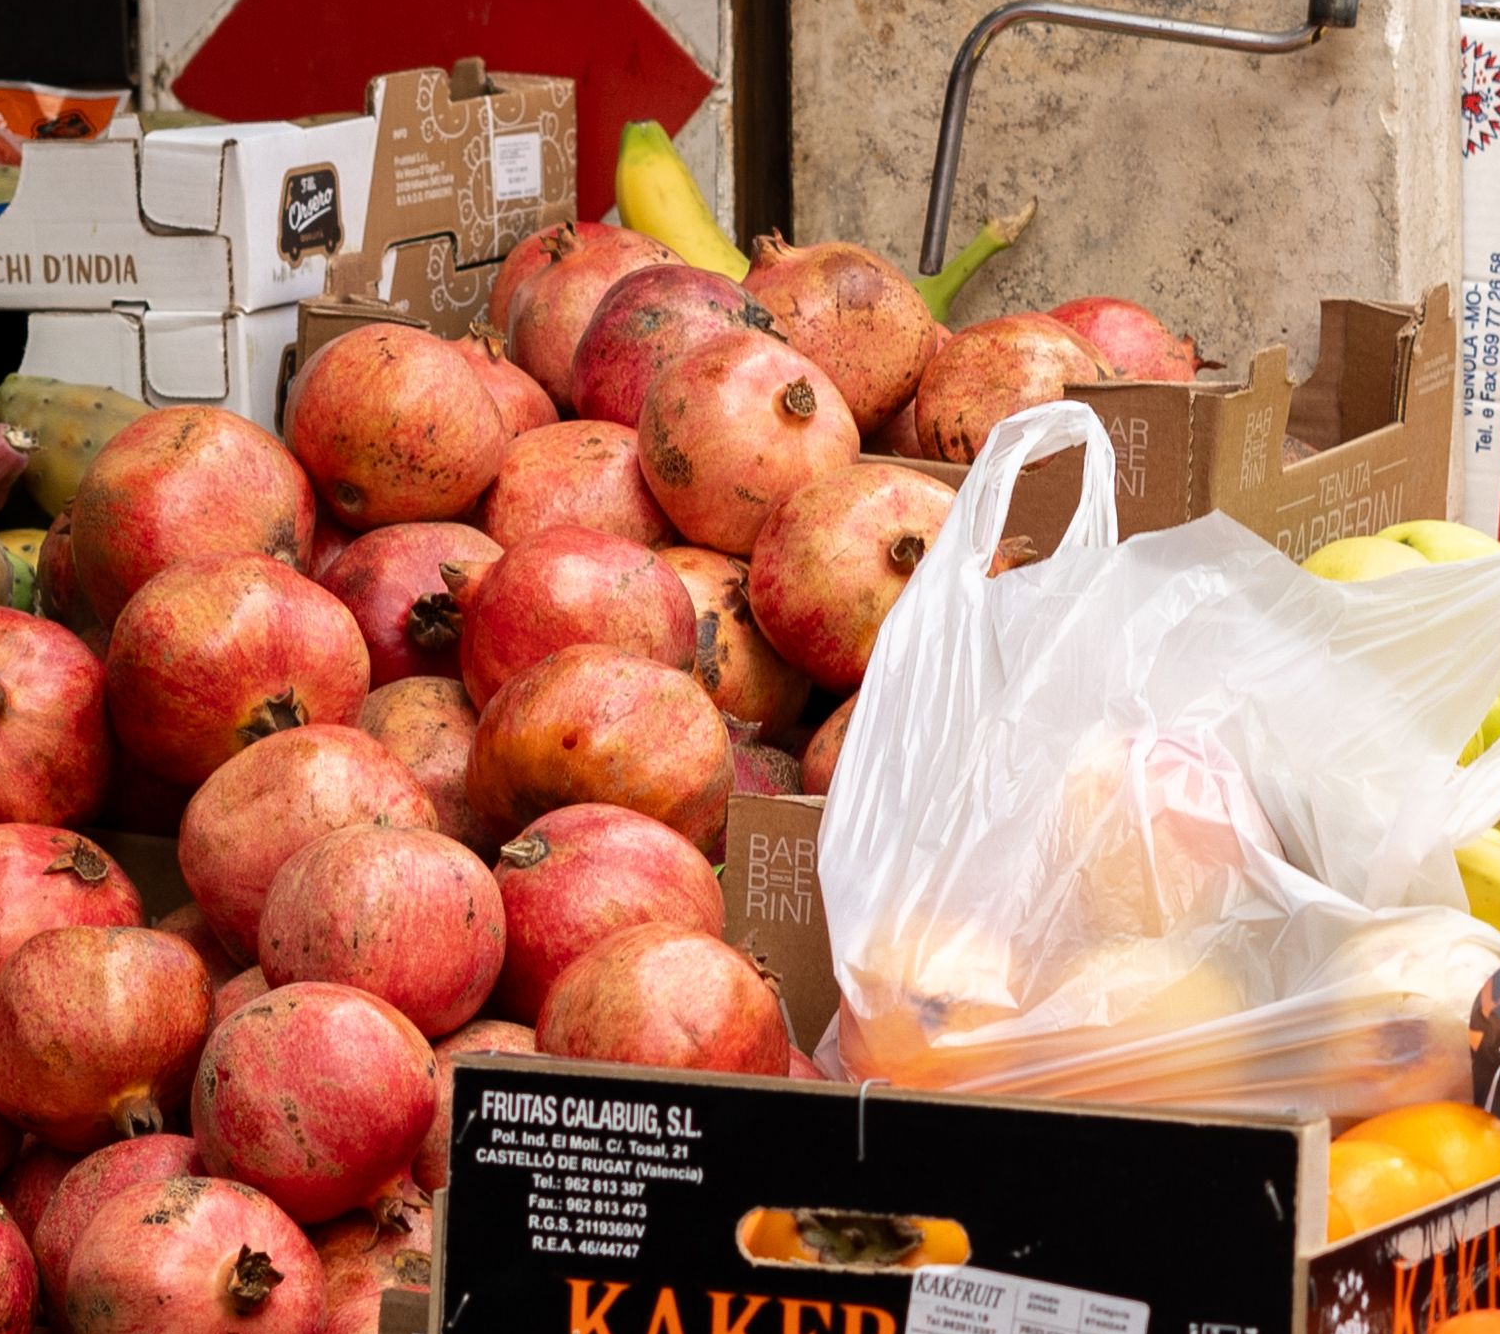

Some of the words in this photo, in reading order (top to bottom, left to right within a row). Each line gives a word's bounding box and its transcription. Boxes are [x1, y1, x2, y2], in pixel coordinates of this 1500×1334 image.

[288, 188, 334, 230] Orsero
[43, 254, 138, 285] D'INDIA
[1482, 334, 1500, 368] 059
[1480, 371, 1498, 403] Fax
[1246, 406, 1273, 434] BAR
[1481, 408, 1495, 419] e
[1475, 419, 1494, 453] Tel.
[1239, 457, 1267, 492] RINI
[1318, 460, 1371, 508] TENUTA
[750, 833, 816, 868] BAR
[747, 890, 813, 926] RINI
[482, 1090, 557, 1126] FRUTAS
[562, 1097, 662, 1139] CALABUIG,
[667, 1106, 702, 1138] S.L.
[492, 1128, 518, 1145] Pol.
[522, 1131, 548, 1147] Ind.
[552, 1134, 566, 1149] El
[606, 1139, 625, 1154] C/.
[628, 1140, 668, 1159] Tosal,
[672, 1145, 689, 1159] 21
[476, 1147, 554, 1168] CASTELLÓ
[558, 1155, 578, 1170] DE
[582, 1157, 632, 1175] RUGAT
[635, 1162, 703, 1184] (Valencia)
[532, 1173, 561, 1189] Tel.:
[565, 1176, 589, 1193] 962
[593, 1180, 618, 1195] 813
[621, 1181, 646, 1197] 387
[528, 1194, 562, 1210] Fax.:
[566, 1197, 590, 1213] 962
[594, 1200, 619, 1215] 813
[622, 1202, 647, 1218] 473
[528, 1214, 572, 1232] R.G.S.
[575, 1218, 646, 1239] 2119369/V
[532, 1235, 575, 1253] R.E.A.
[578, 1239, 640, 1258] 46/44747
[915, 1271, 1006, 1309] KAKFRUIT
